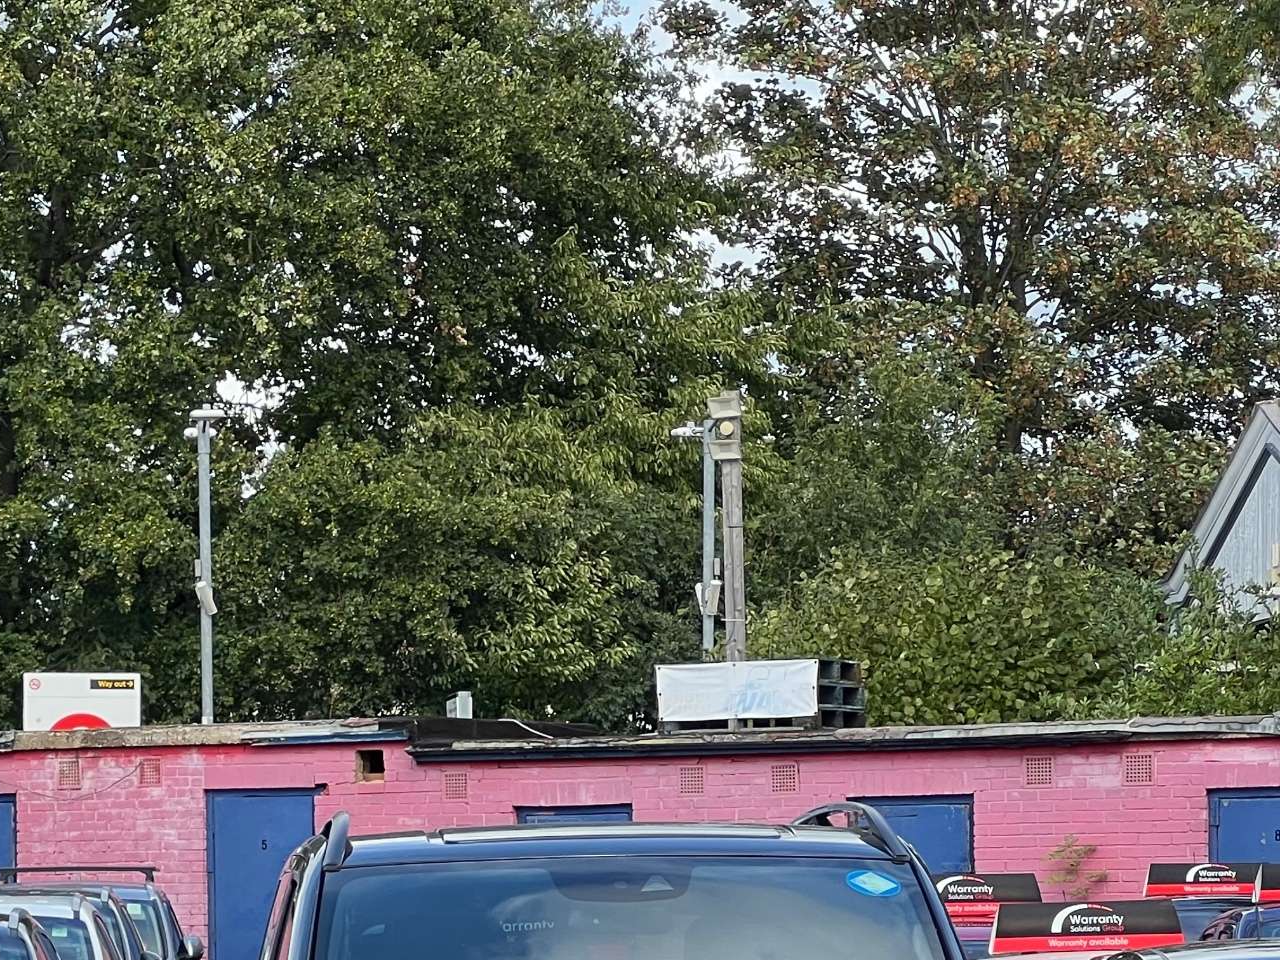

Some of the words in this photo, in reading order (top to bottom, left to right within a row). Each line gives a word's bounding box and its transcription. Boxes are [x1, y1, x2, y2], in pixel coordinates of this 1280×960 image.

[261, 839, 268, 851] 5
[1198, 870, 1236, 879] Warranty
[947, 884, 994, 895] Warranty
[1069, 914, 1124, 926] Warranty
[1101, 924, 1125, 932] Group
[1048, 937, 1088, 948] Warranty
[1088, 936, 1129, 946] available
